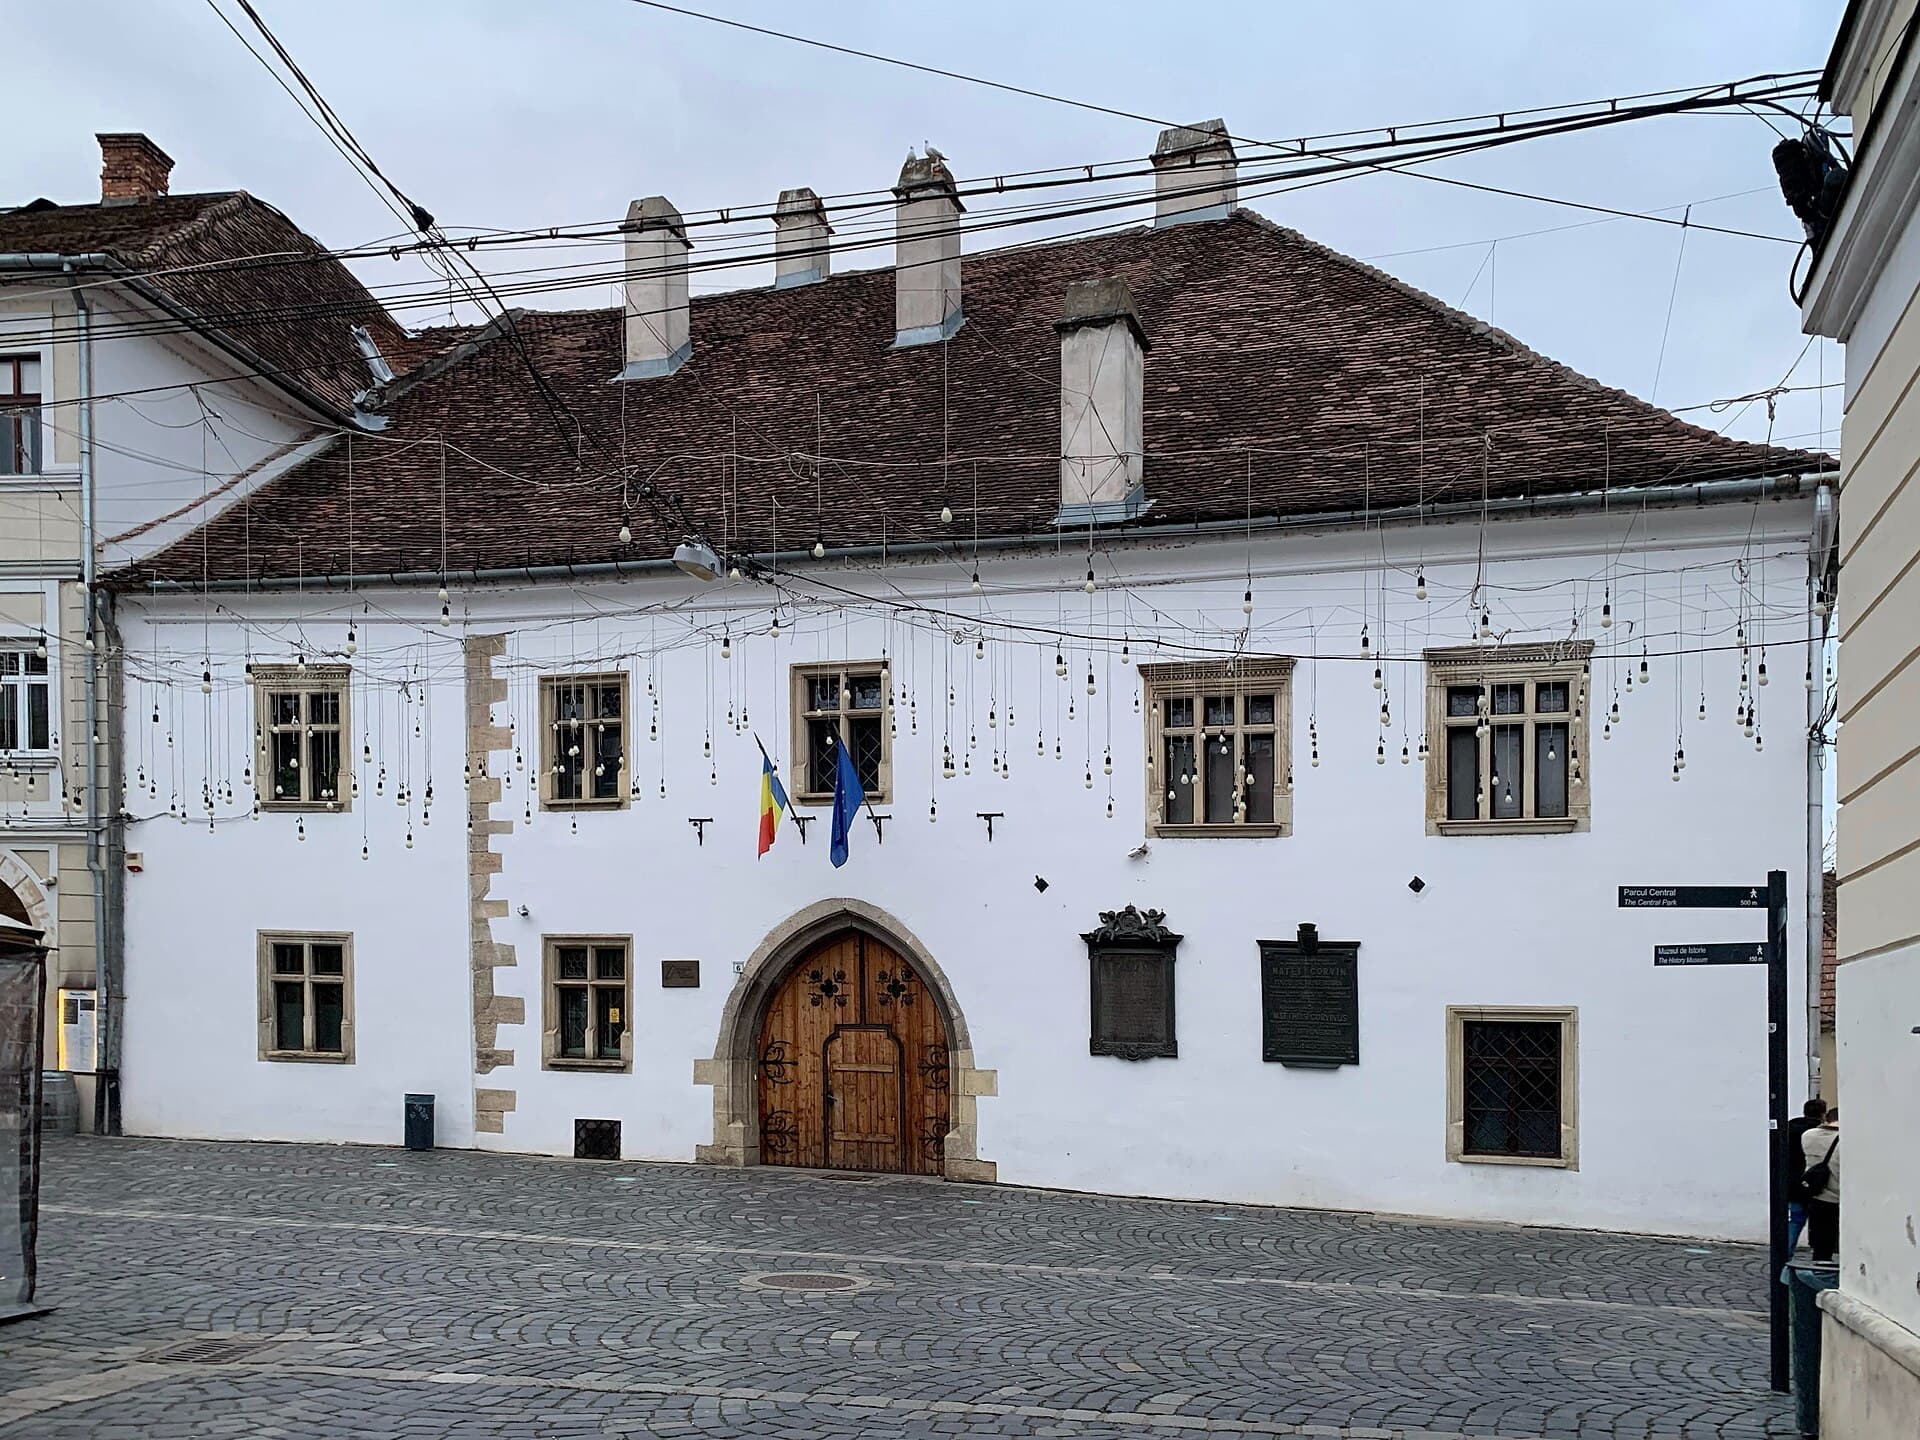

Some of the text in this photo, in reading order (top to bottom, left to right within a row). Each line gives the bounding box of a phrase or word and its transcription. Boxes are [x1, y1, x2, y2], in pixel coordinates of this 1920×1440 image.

[1623, 888, 1677, 896] Parcul Central
[1679, 946, 1688, 954] de
[1272, 967, 1347, 976] MATEI CORVIN
